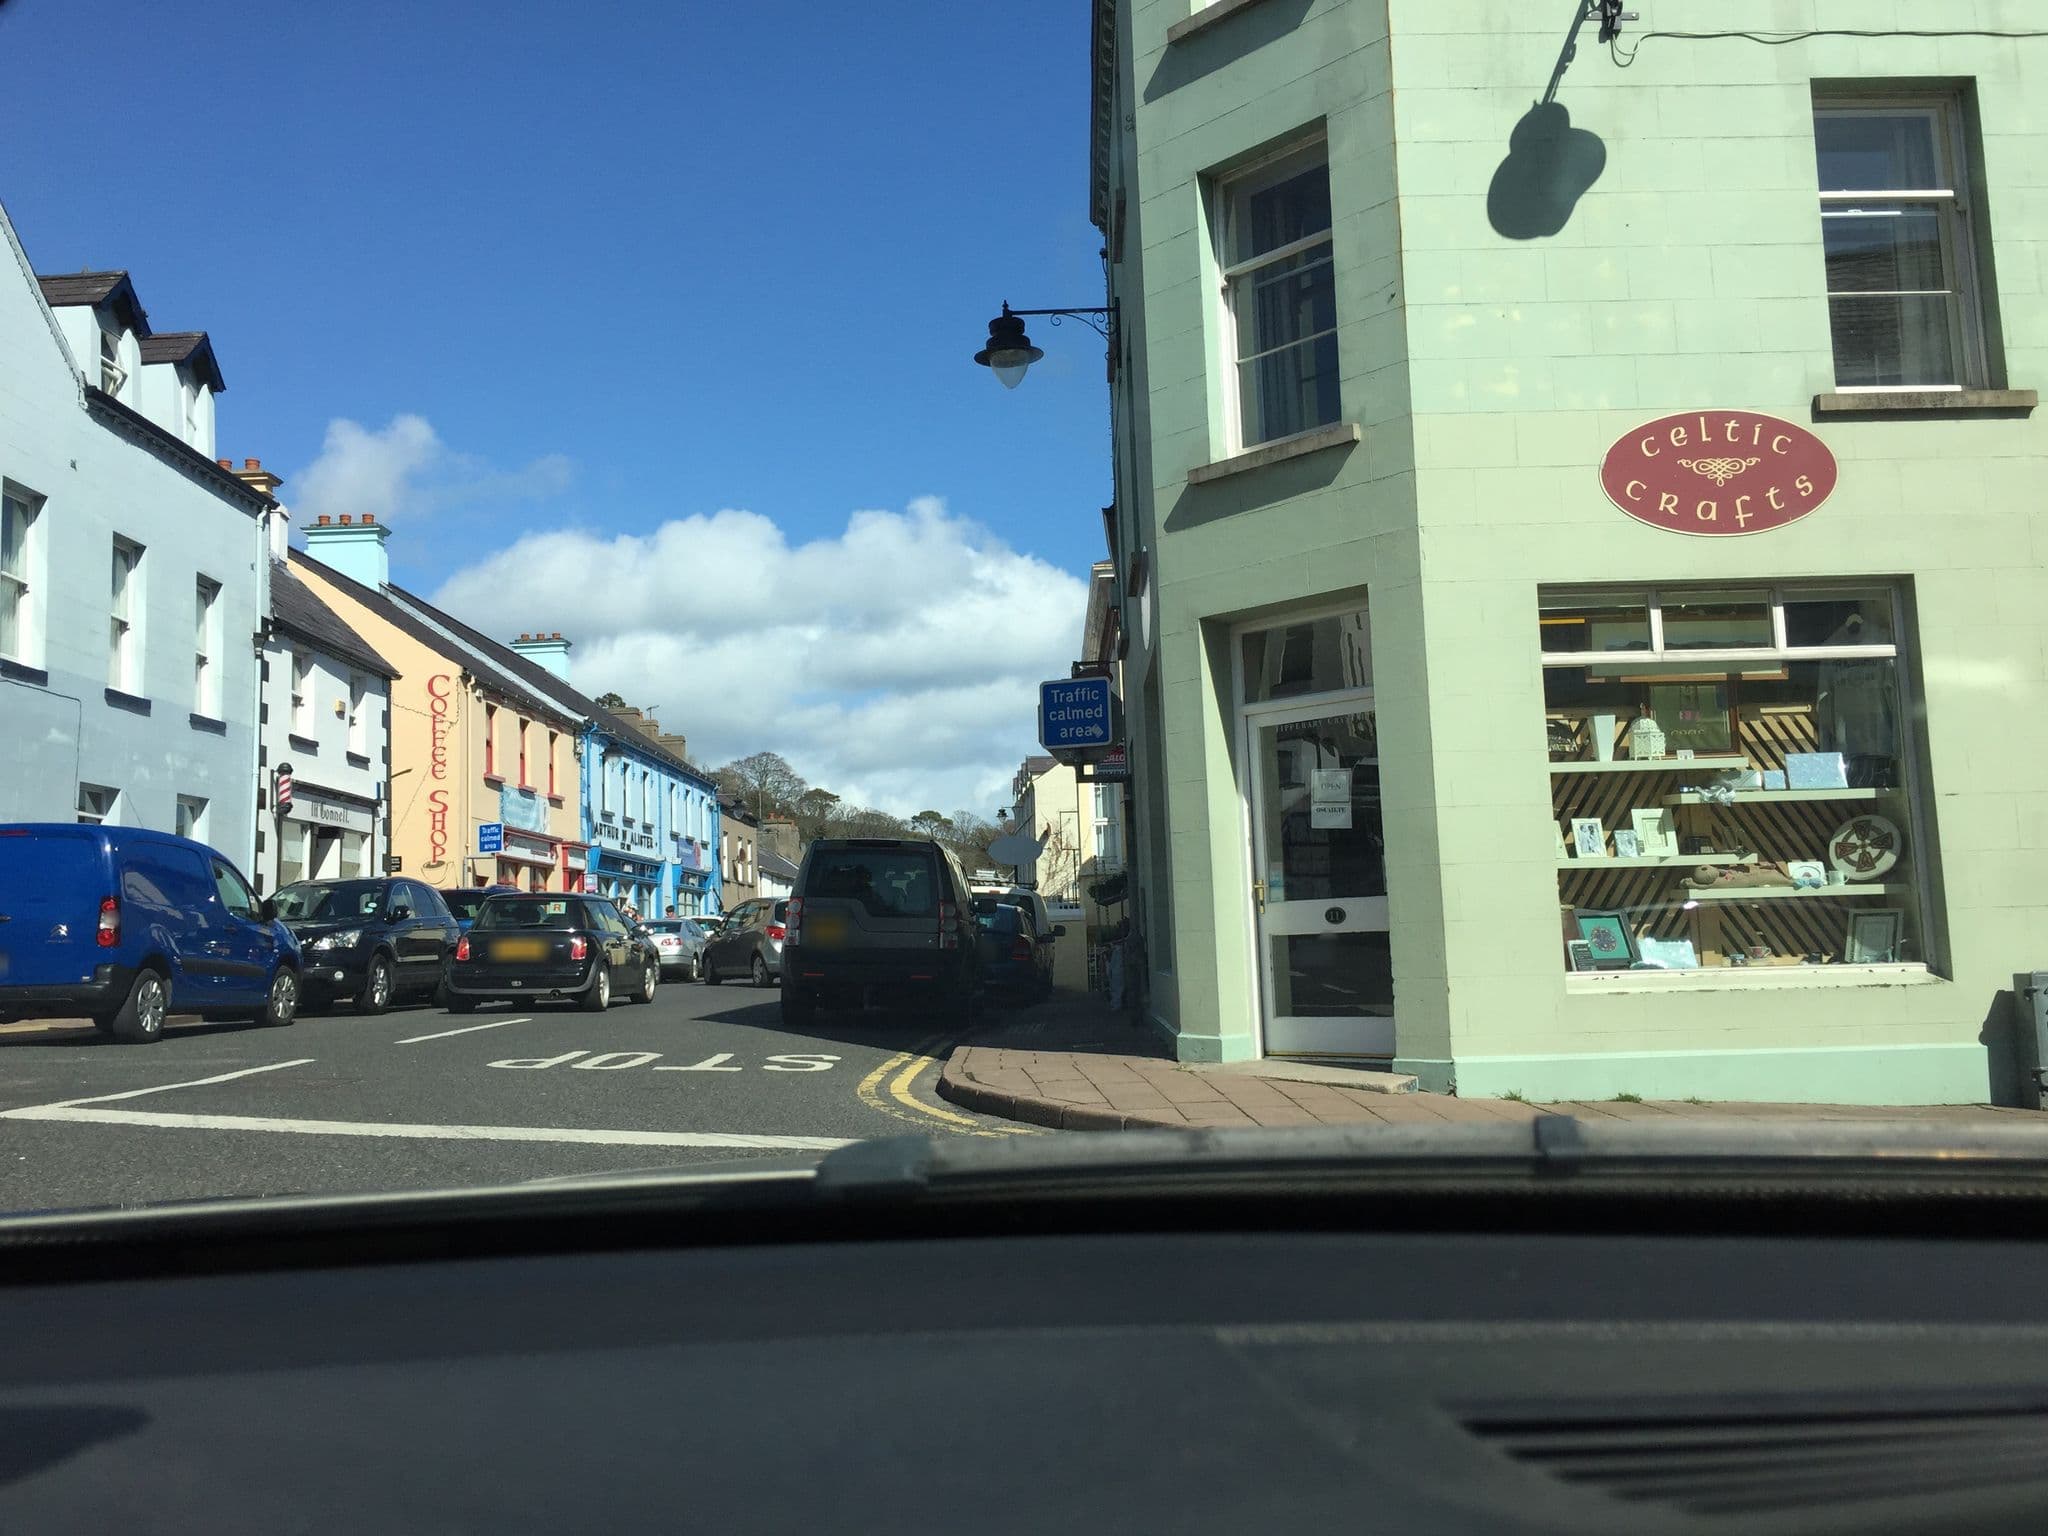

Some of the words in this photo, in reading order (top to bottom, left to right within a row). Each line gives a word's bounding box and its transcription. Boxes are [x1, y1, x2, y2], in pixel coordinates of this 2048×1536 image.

[1641, 416, 1793, 458] Celtic
[1051, 687, 1099, 703] Traffic
[1049, 704, 1103, 720] calmed
[1060, 725, 1092, 738] area
[428, 790, 449, 863] SHOP
[481, 826, 499, 834] Traffic
[594, 821, 619, 841] ARTHUR
[486, 1050, 842, 1072] STOP
